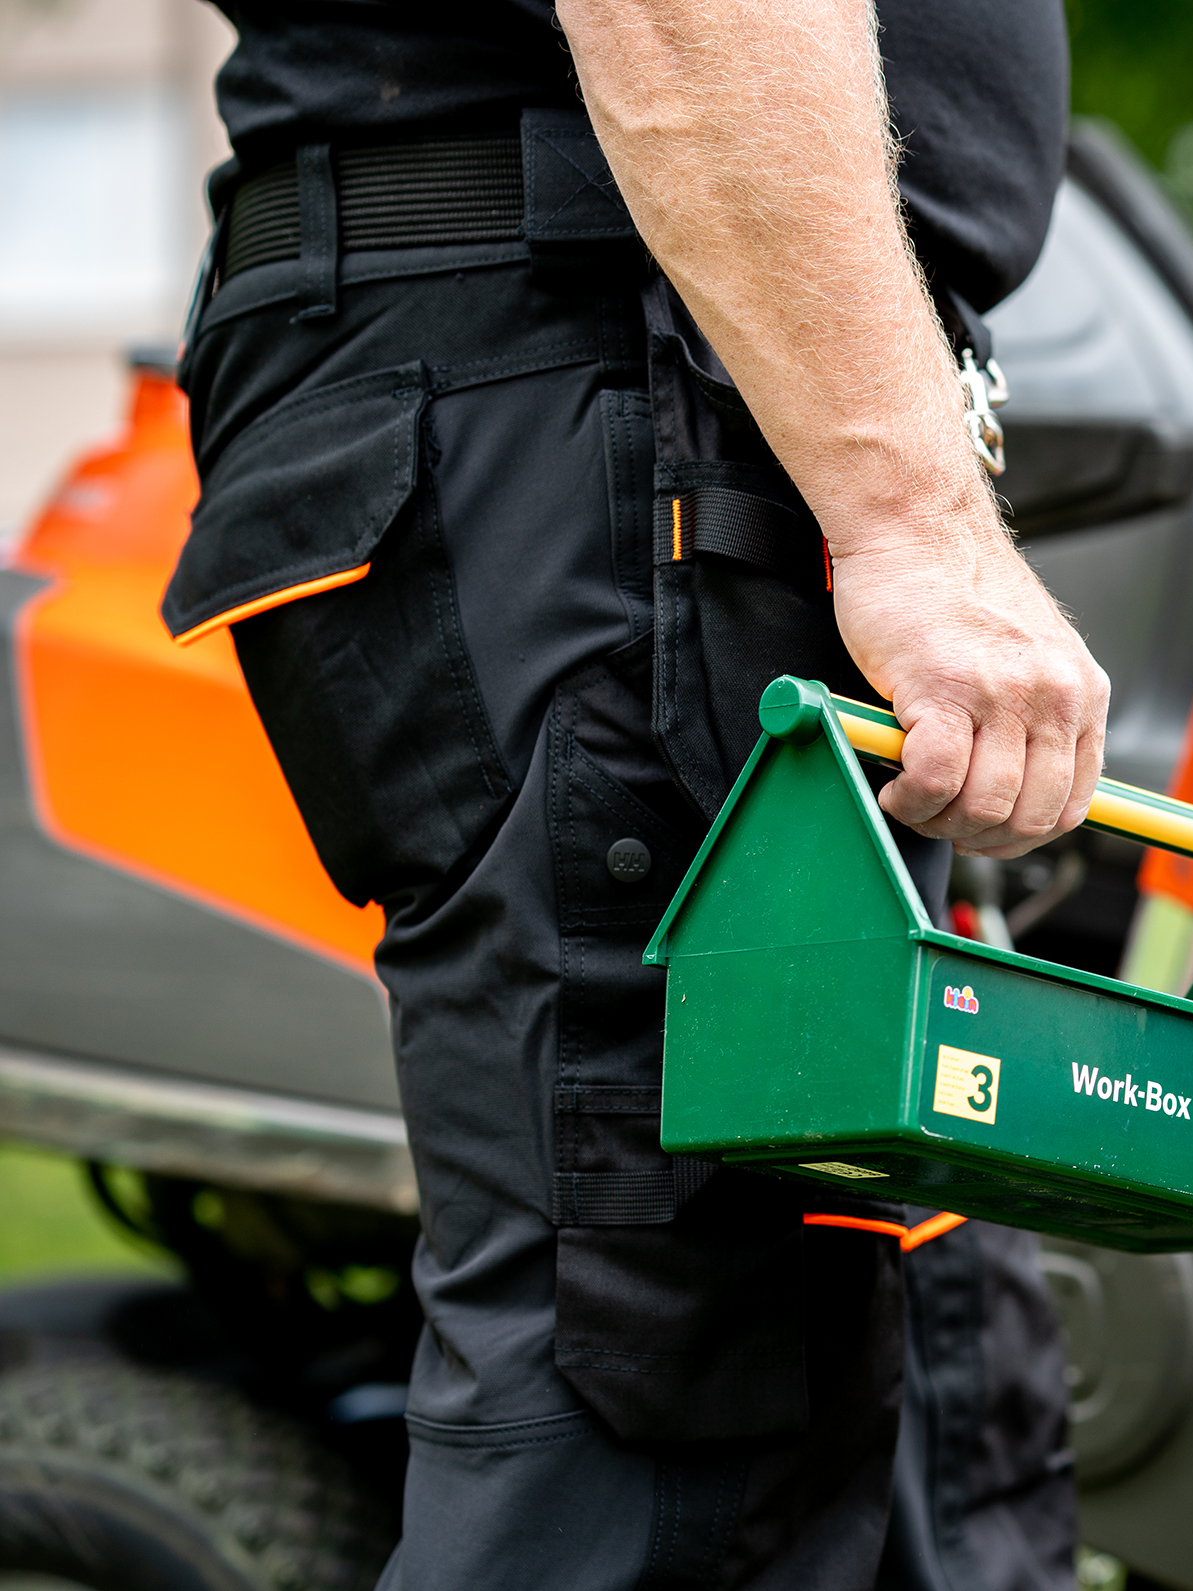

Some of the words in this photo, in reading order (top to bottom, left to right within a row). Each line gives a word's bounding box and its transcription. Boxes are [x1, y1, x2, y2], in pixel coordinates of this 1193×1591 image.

[945, 986, 978, 1013] klein
[966, 1064, 993, 1113] 3
[1071, 1061, 1192, 1120] Work-Box
